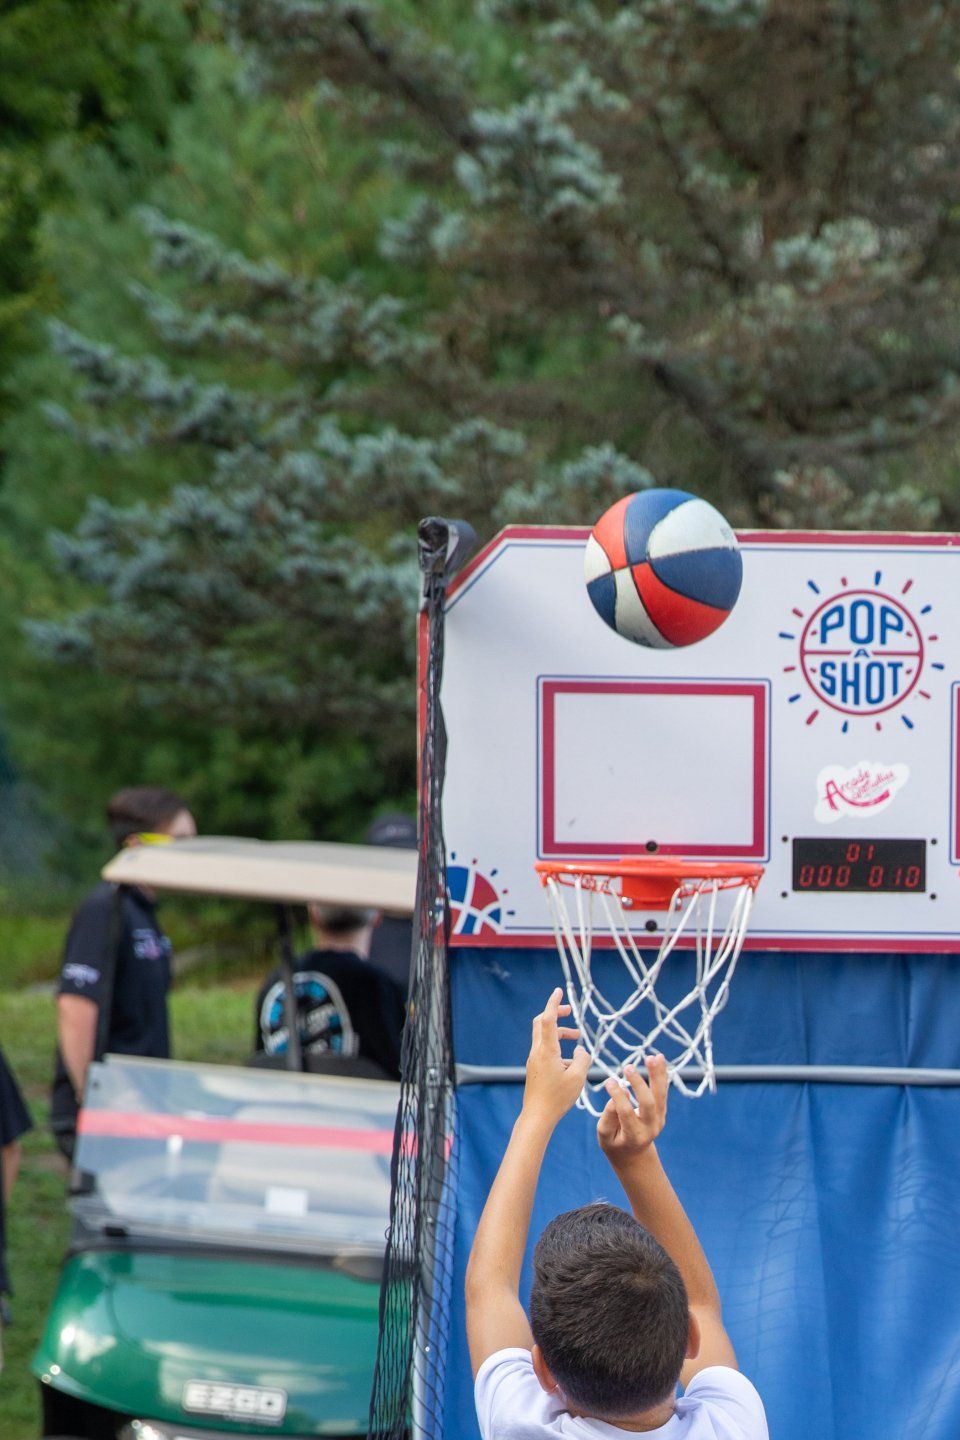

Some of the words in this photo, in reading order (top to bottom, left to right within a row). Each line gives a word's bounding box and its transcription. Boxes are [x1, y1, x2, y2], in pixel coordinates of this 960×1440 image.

[820, 599, 904, 645] POP
[854, 648, 869, 658] A
[820, 661, 903, 706] SHOT
[846, 844, 875, 862] 01
[799, 865, 850, 887] 000
[869, 865, 920, 888] 010
